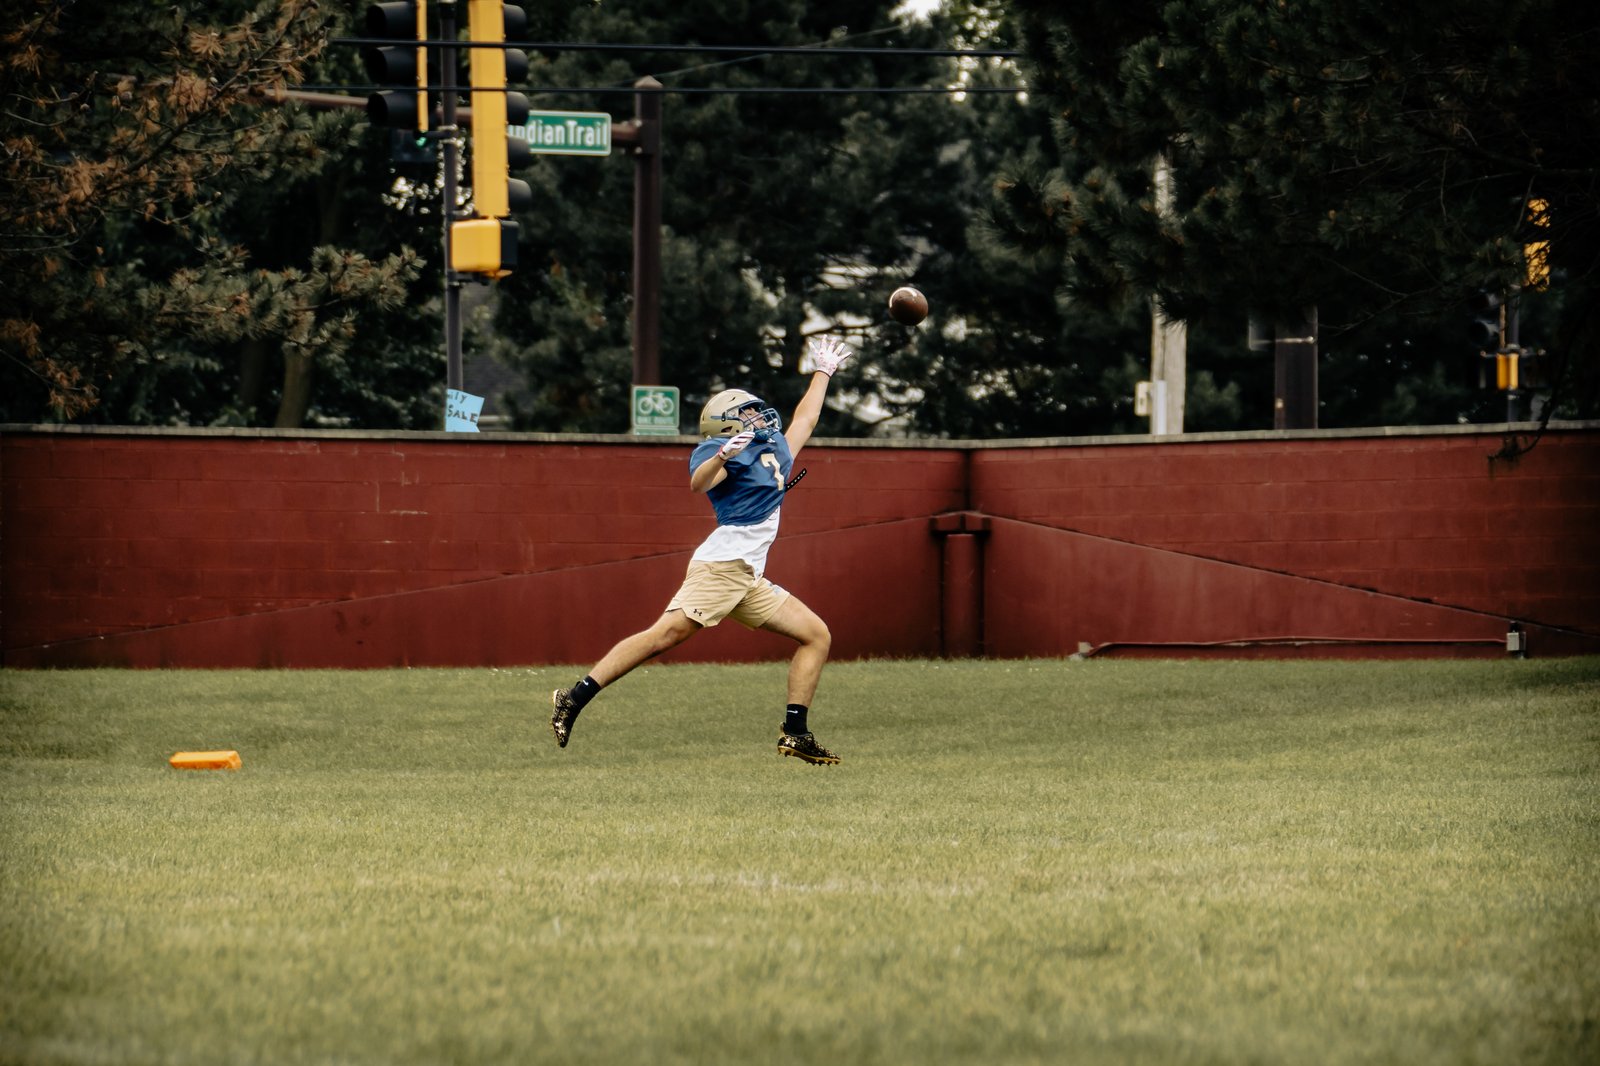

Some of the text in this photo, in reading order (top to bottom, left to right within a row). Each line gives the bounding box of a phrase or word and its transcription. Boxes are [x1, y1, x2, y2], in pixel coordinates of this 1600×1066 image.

[565, 120, 608, 146] Trail
[447, 404, 478, 424] SALE
[760, 453, 785, 491] 7
